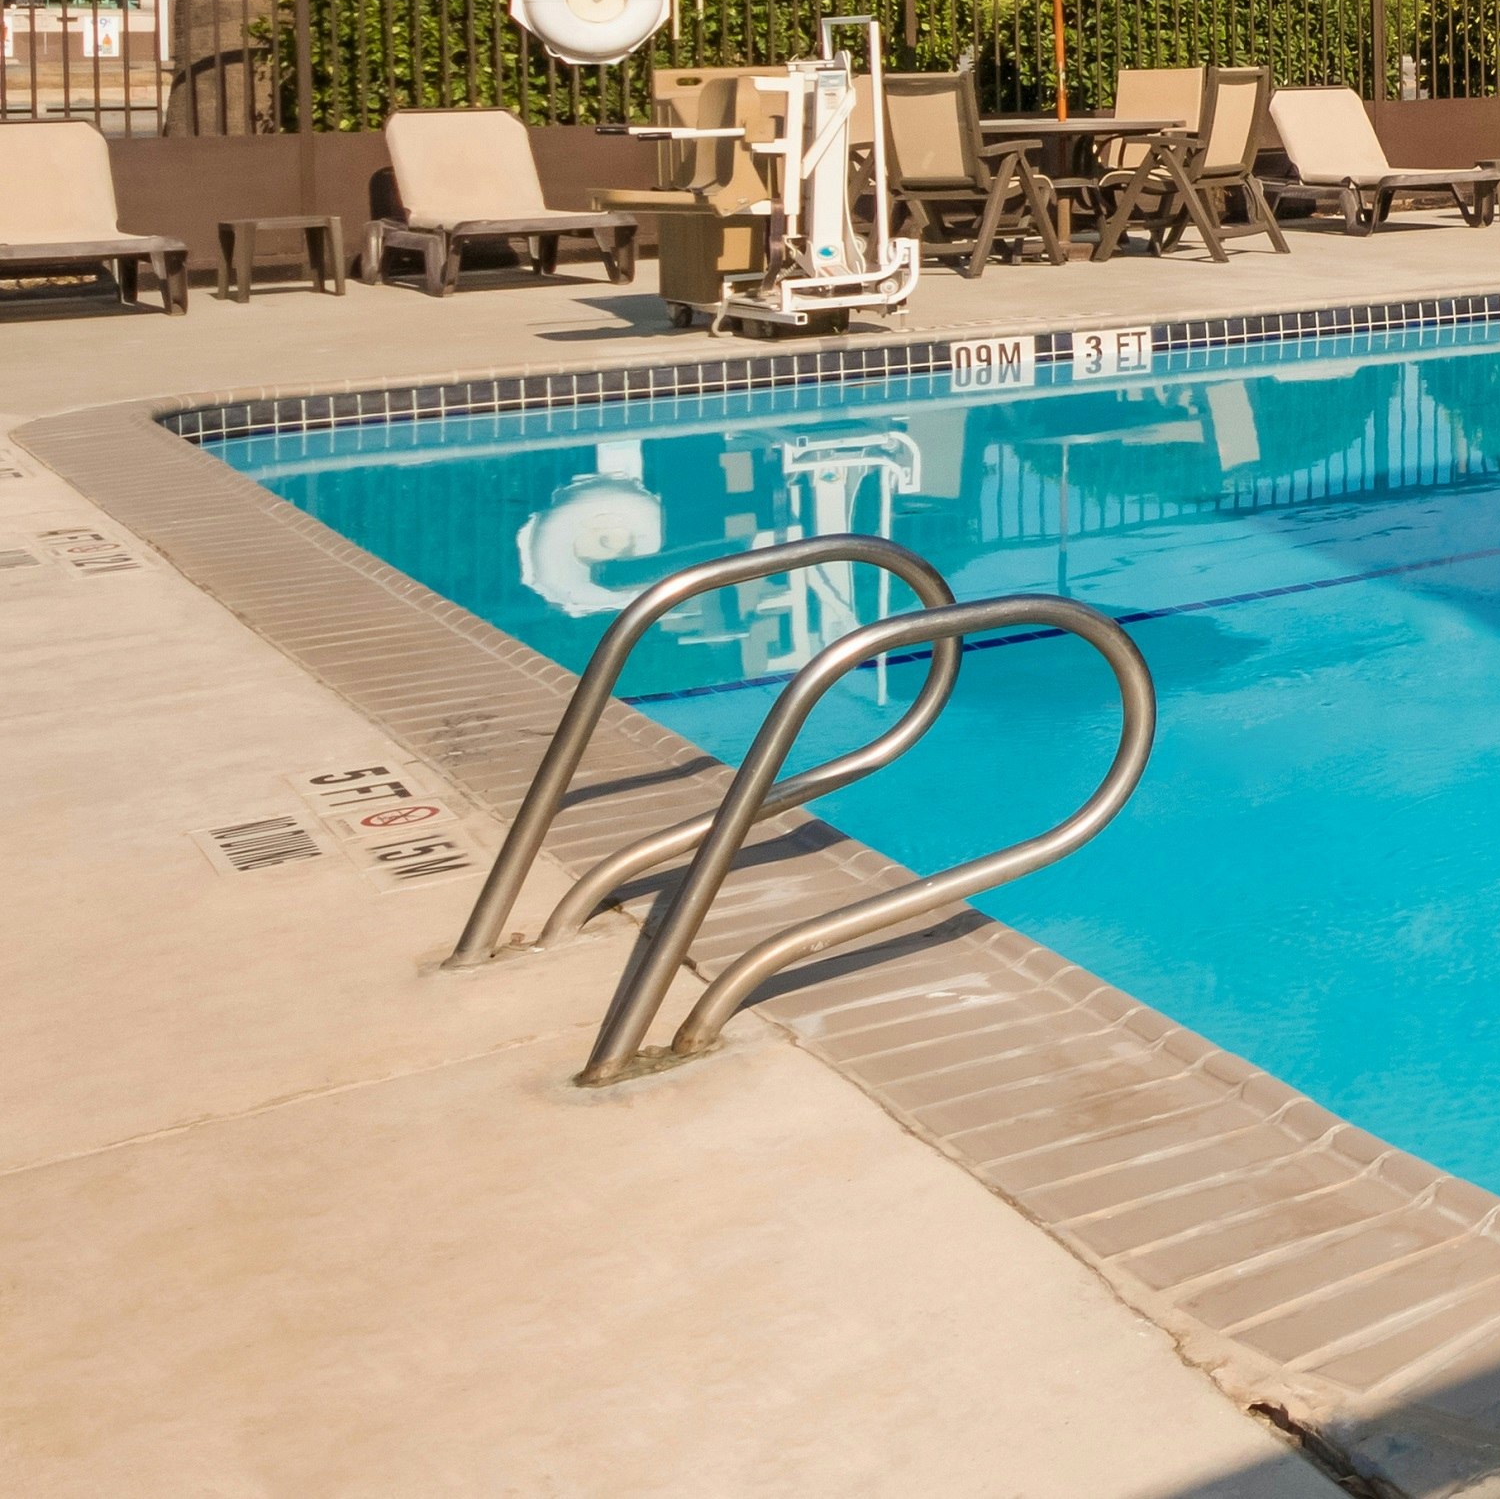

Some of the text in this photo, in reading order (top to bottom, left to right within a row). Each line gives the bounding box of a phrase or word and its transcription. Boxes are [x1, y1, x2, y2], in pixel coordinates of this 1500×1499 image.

[1085, 335, 1103, 357] 3
[1116, 332, 1148, 355] FT
[309, 766, 412, 807] 5 FT
